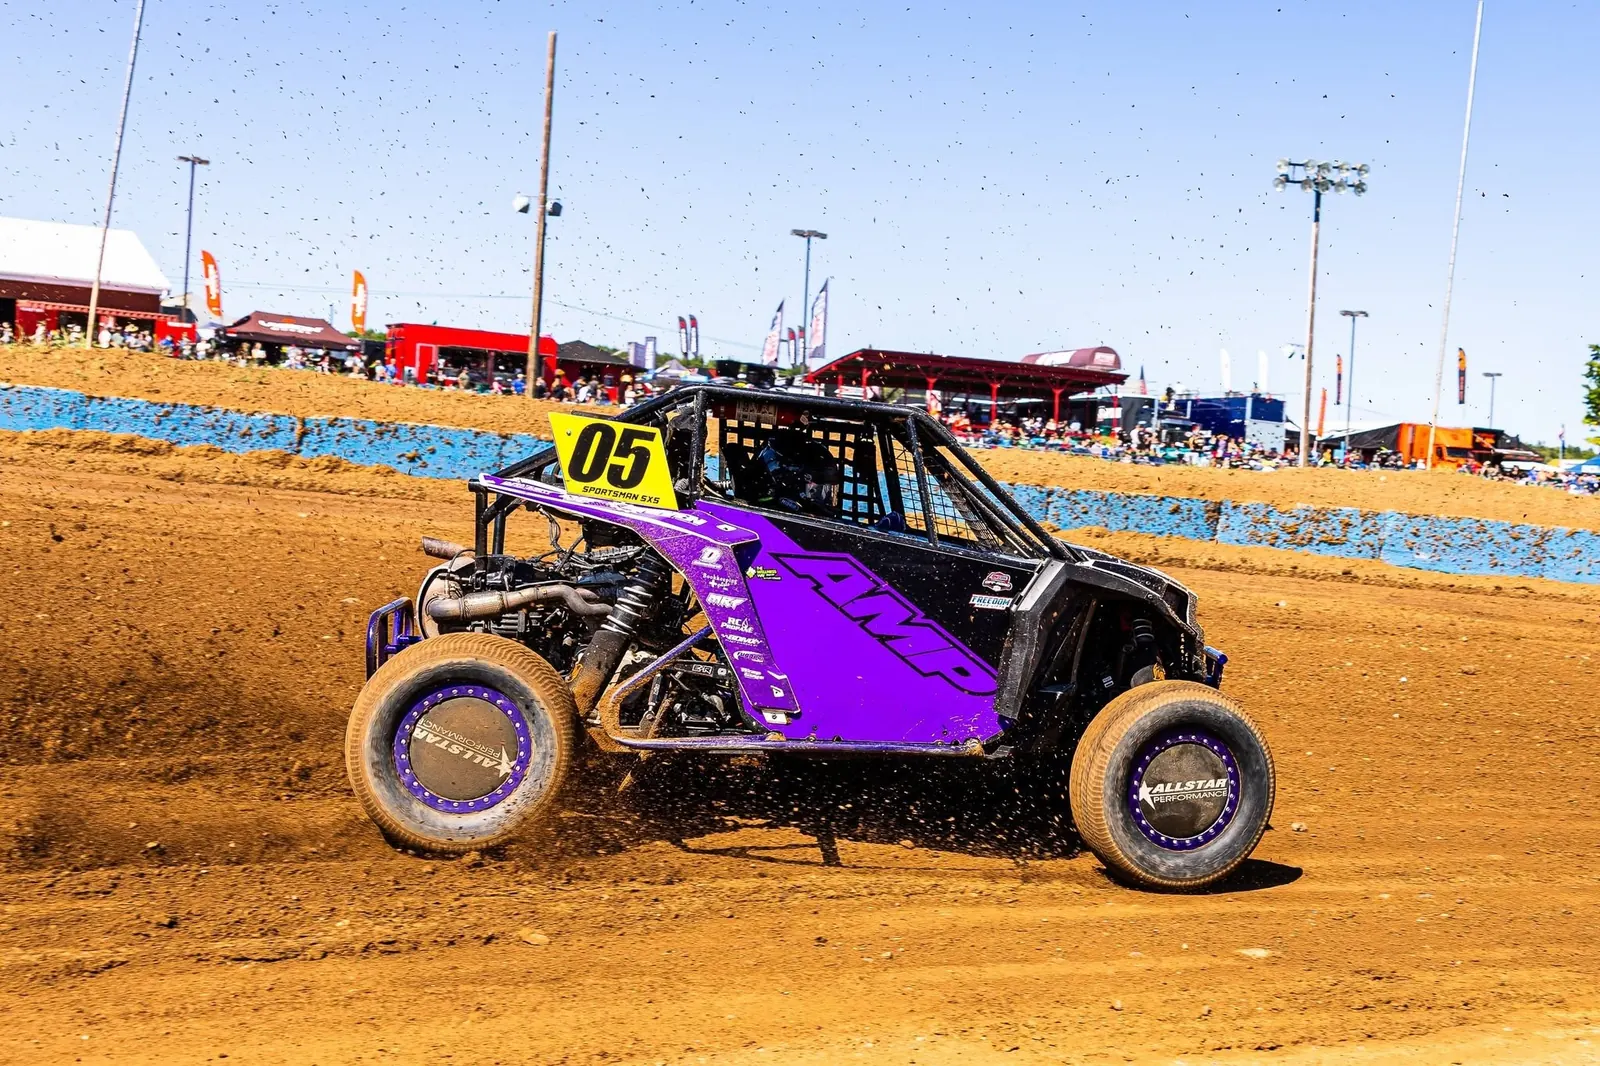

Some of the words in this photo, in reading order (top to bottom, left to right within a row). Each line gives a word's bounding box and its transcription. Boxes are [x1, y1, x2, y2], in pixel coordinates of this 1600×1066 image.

[568, 423, 656, 489] 05
[582, 485, 640, 500] SPORTSMAN
[640, 494, 660, 504] SXS
[972, 595, 1010, 606] FREEDOM
[412, 727, 500, 768] ALLSTAR
[1152, 778, 1228, 793] ALLSTAR
[1153, 790, 1227, 803] PERFORMANCE
